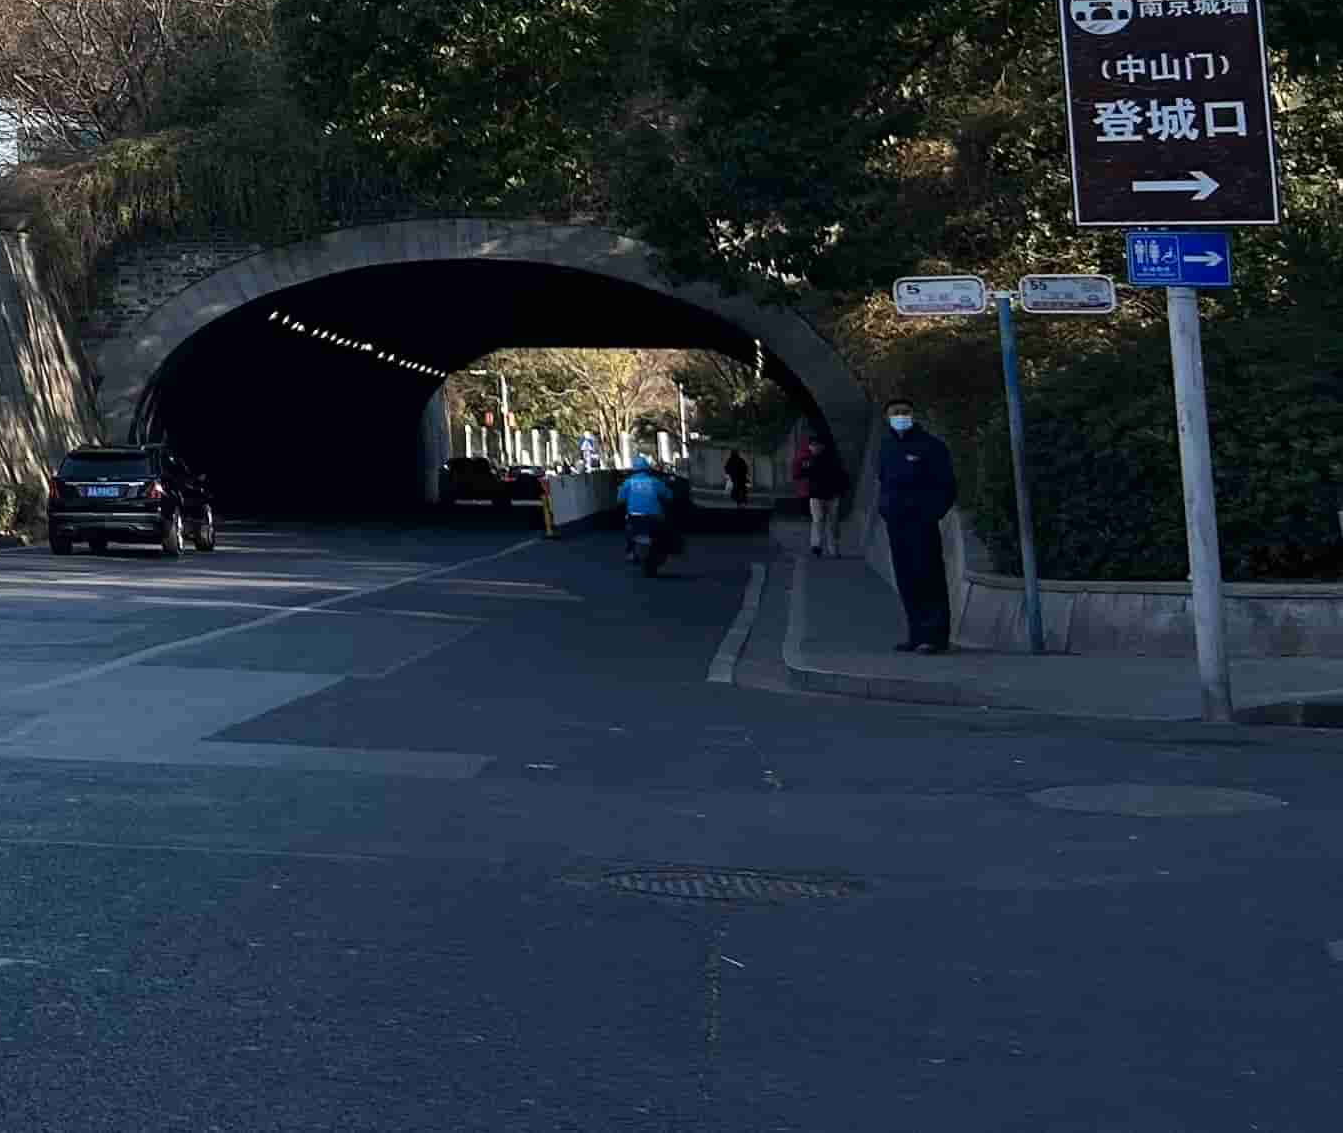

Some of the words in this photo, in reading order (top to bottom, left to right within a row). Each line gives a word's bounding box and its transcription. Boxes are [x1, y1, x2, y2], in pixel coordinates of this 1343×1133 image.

[1101, 52, 1230, 83] （中山门）
[1092, 97, 1249, 142] 登城口
